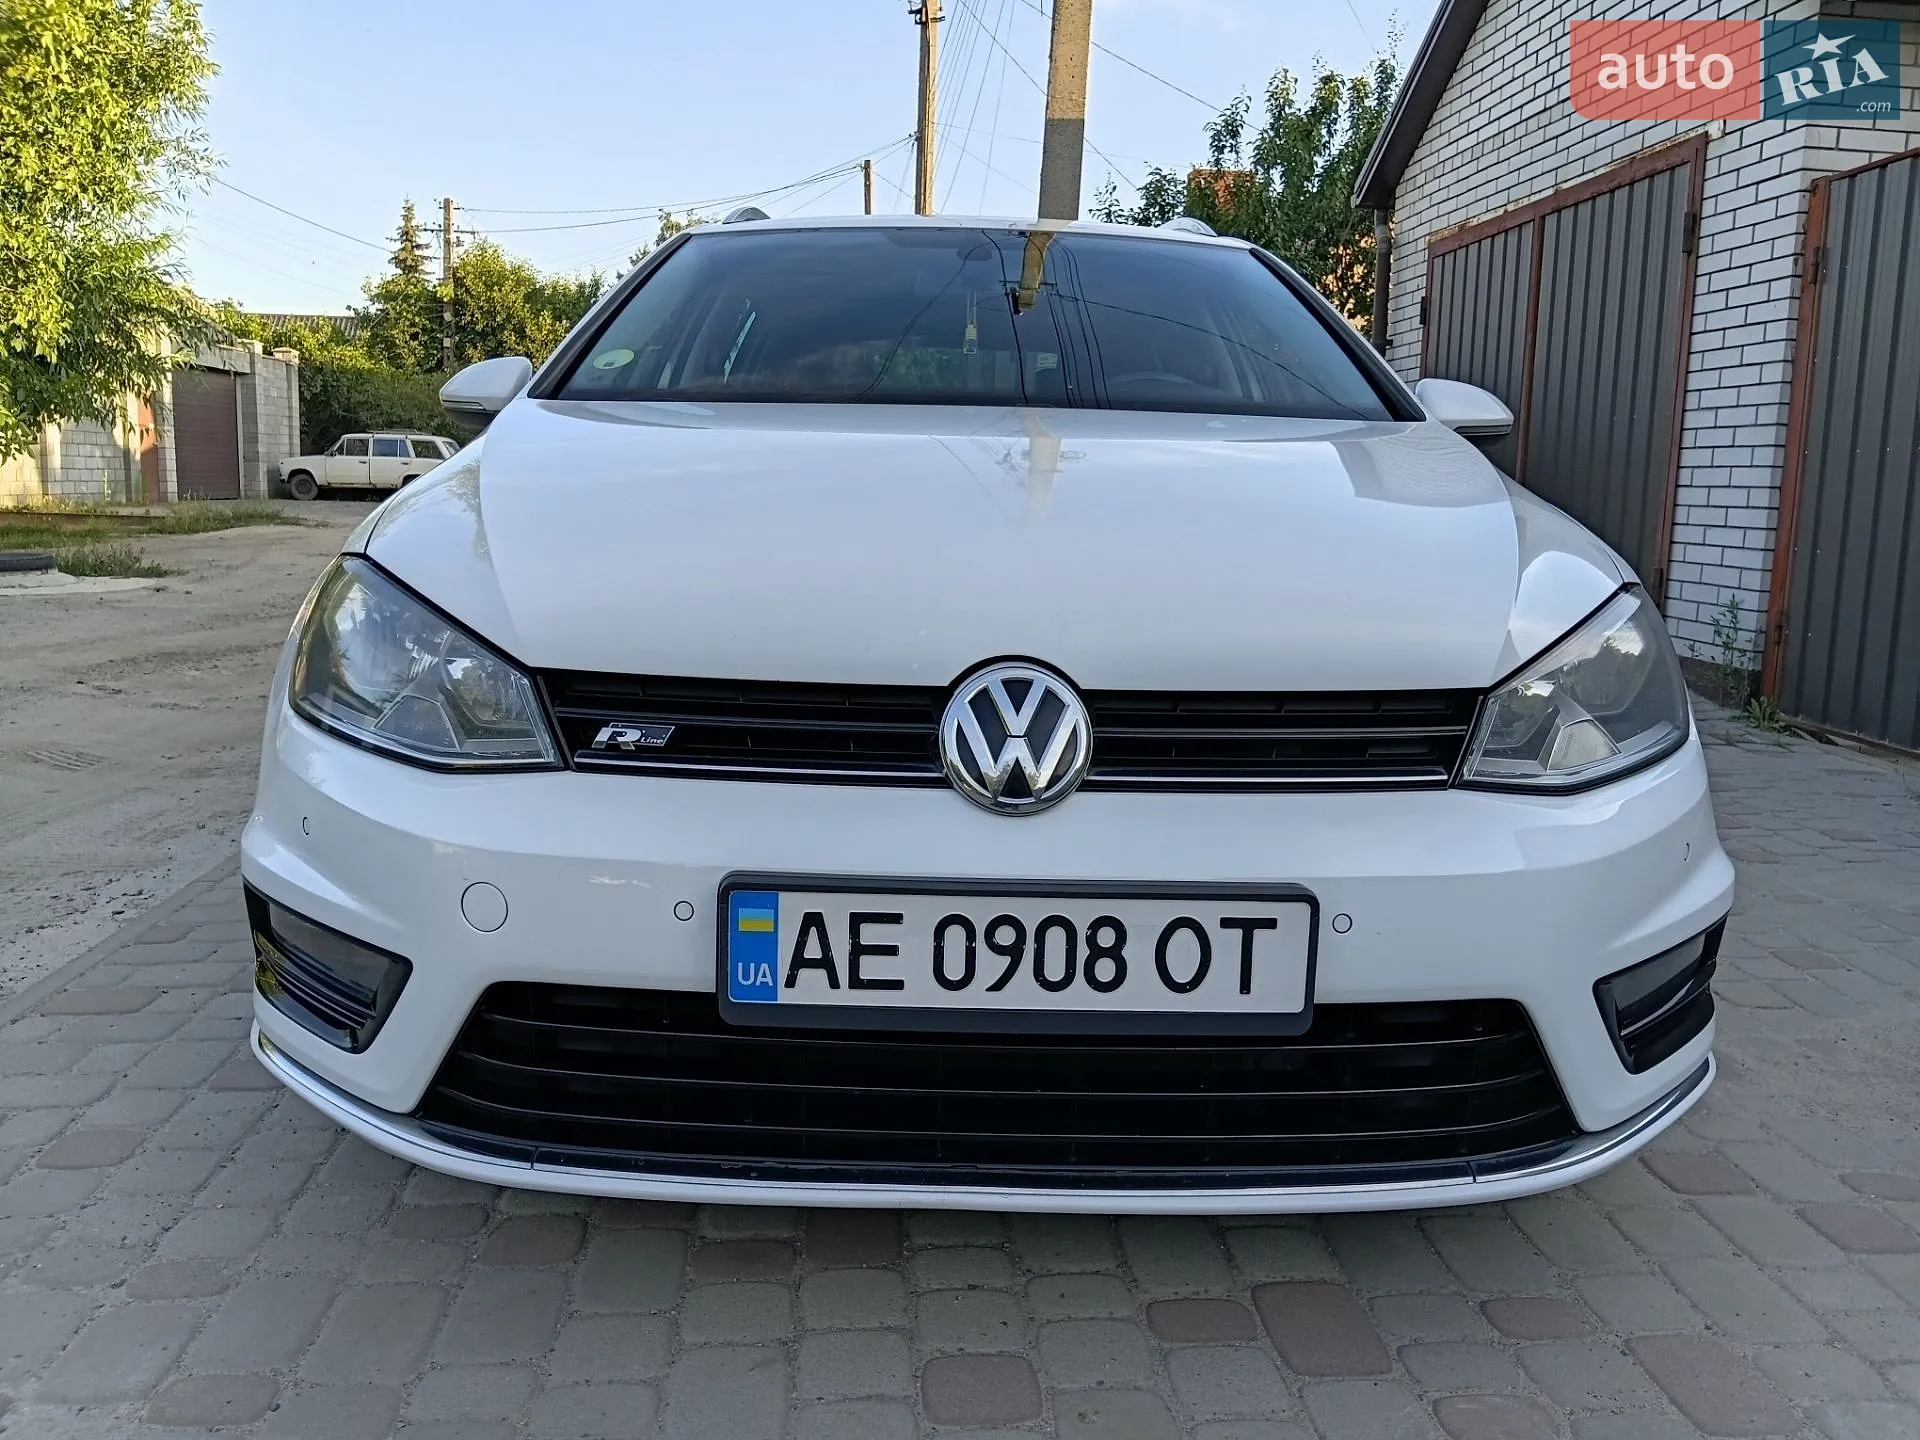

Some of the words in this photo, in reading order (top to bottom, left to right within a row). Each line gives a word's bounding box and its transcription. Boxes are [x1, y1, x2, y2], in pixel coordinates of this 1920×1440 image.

[737, 962, 774, 986] UA
[783, 911, 905, 990] AE
[932, 913, 1128, 993] 0908
[1154, 916, 1278, 996] OT
